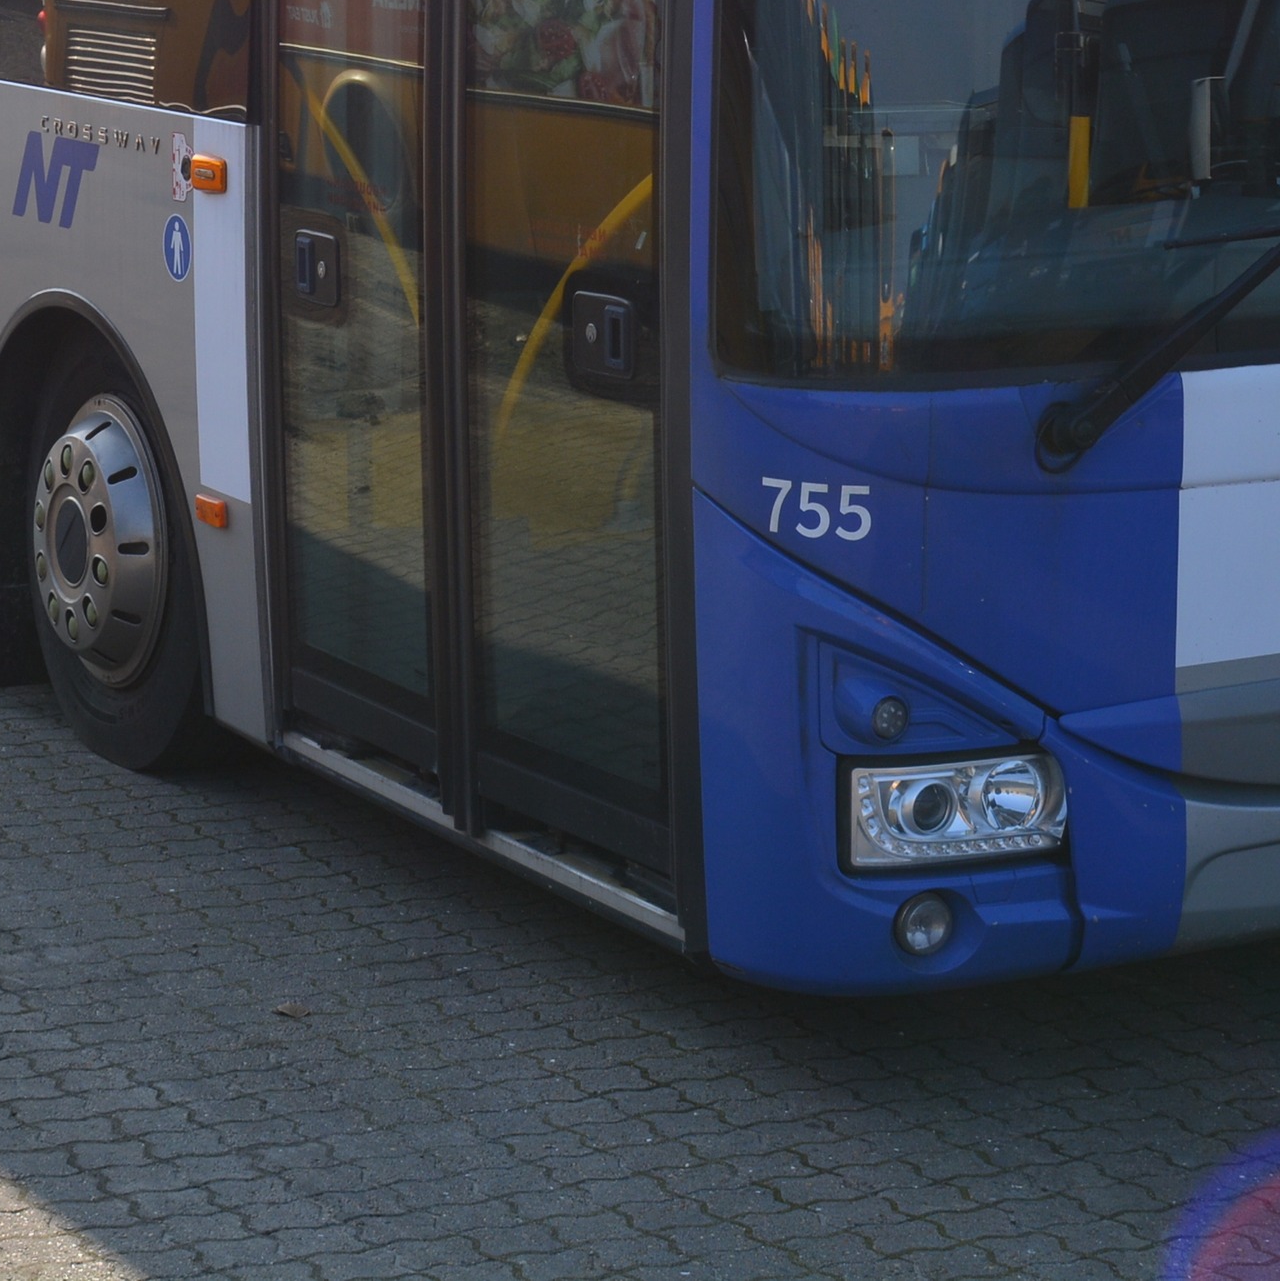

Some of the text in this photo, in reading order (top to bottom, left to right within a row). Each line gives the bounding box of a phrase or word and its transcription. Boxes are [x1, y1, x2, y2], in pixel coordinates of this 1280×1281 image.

[40, 115, 161, 155] CROSSWAY
[12, 130, 100, 229] NT
[762, 476, 872, 542] 755
